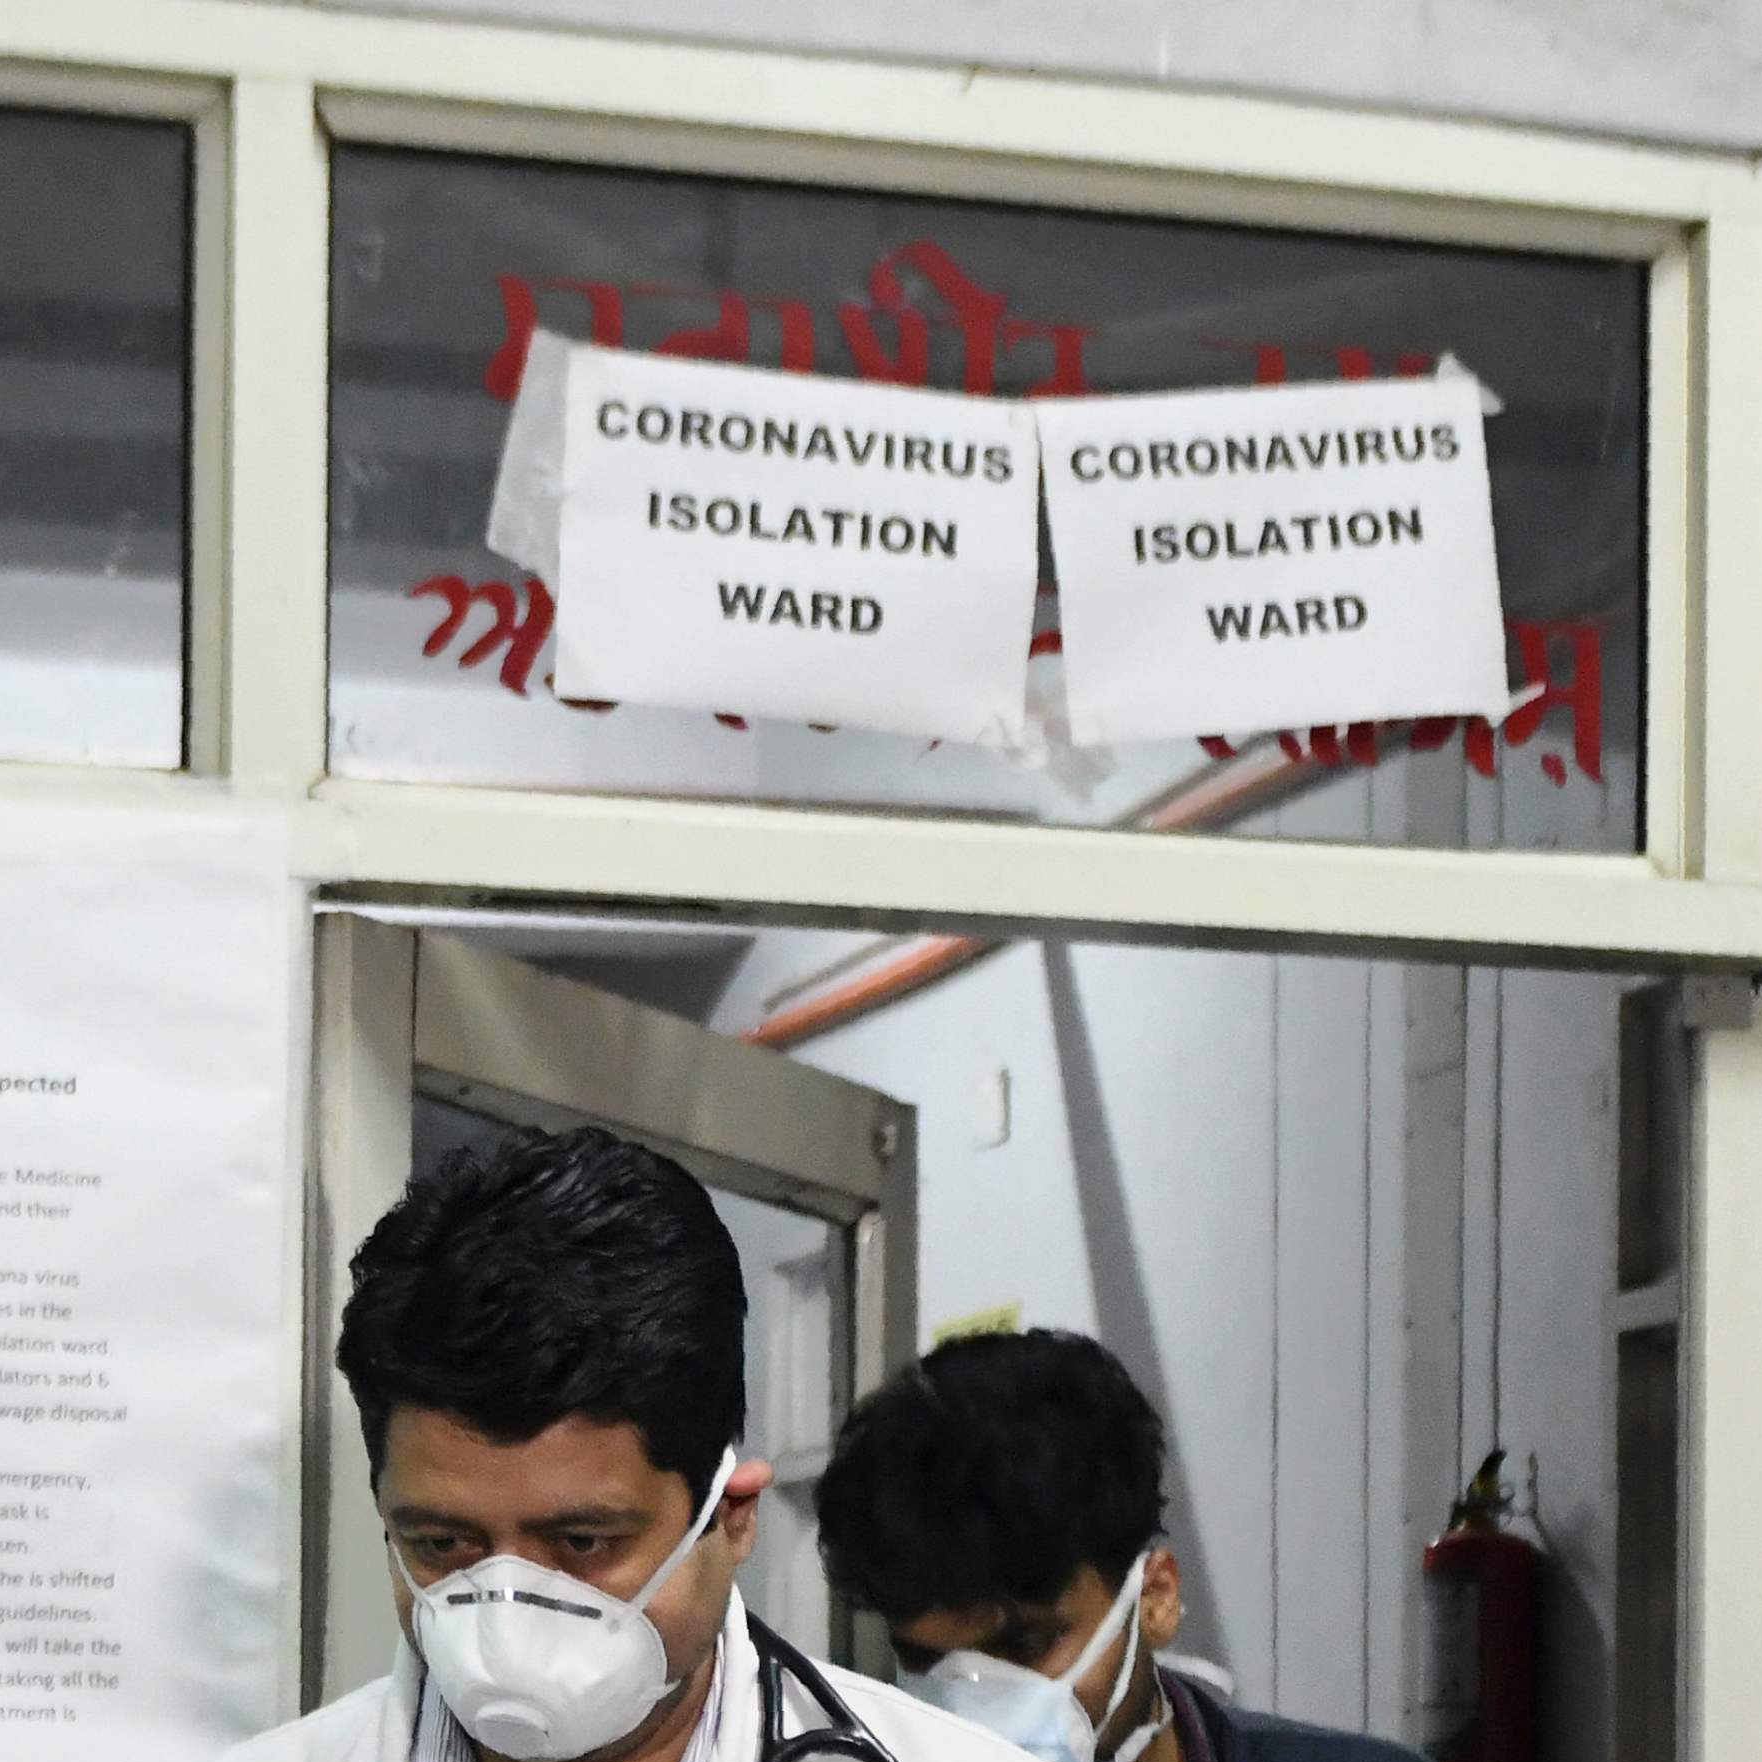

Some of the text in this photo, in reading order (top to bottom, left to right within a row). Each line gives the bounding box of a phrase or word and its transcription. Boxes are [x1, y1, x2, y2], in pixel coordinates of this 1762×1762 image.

[596, 399, 1014, 484] CORONAVIRUS
[1069, 423, 1461, 483] CORONAVIRUS
[647, 491, 958, 561] ISOLATION
[1133, 506, 1424, 564] ISOLATION
[718, 582, 884, 637] WARD
[1206, 593, 1368, 644] WARD
[34, 1267, 80, 1287] virus
[4, 1635, 39, 1654] will
[43, 1636, 84, 1655] take
[90, 1637, 122, 1656] the
